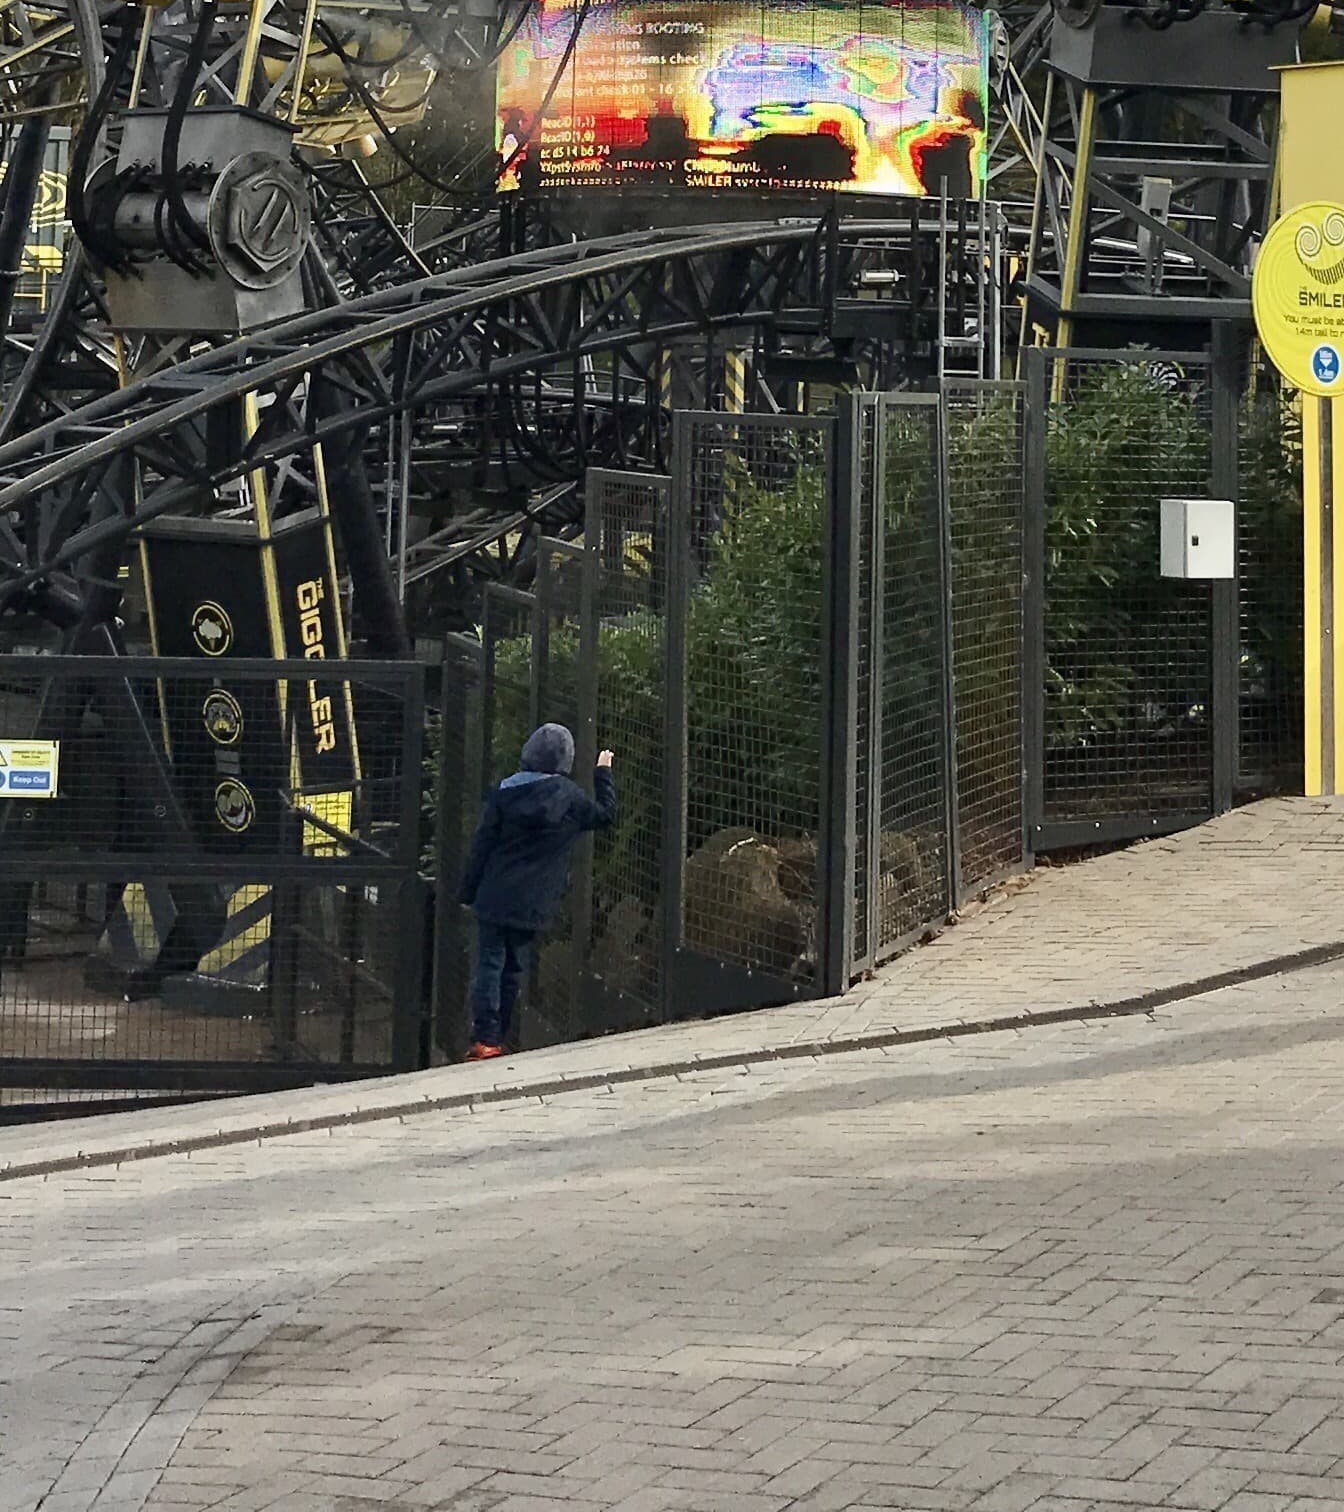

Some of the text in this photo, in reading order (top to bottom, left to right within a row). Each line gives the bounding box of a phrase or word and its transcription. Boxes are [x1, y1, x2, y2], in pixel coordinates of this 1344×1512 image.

[685, 175, 732, 187] SMILER
[1283, 314, 1299, 324] You
[1301, 316, 1322, 325] must
[1323, 316, 1335, 326] be
[1336, 317, 1344, 326] at
[1330, 328, 1339, 337] to
[13, 775, 47, 785] Keep Out
